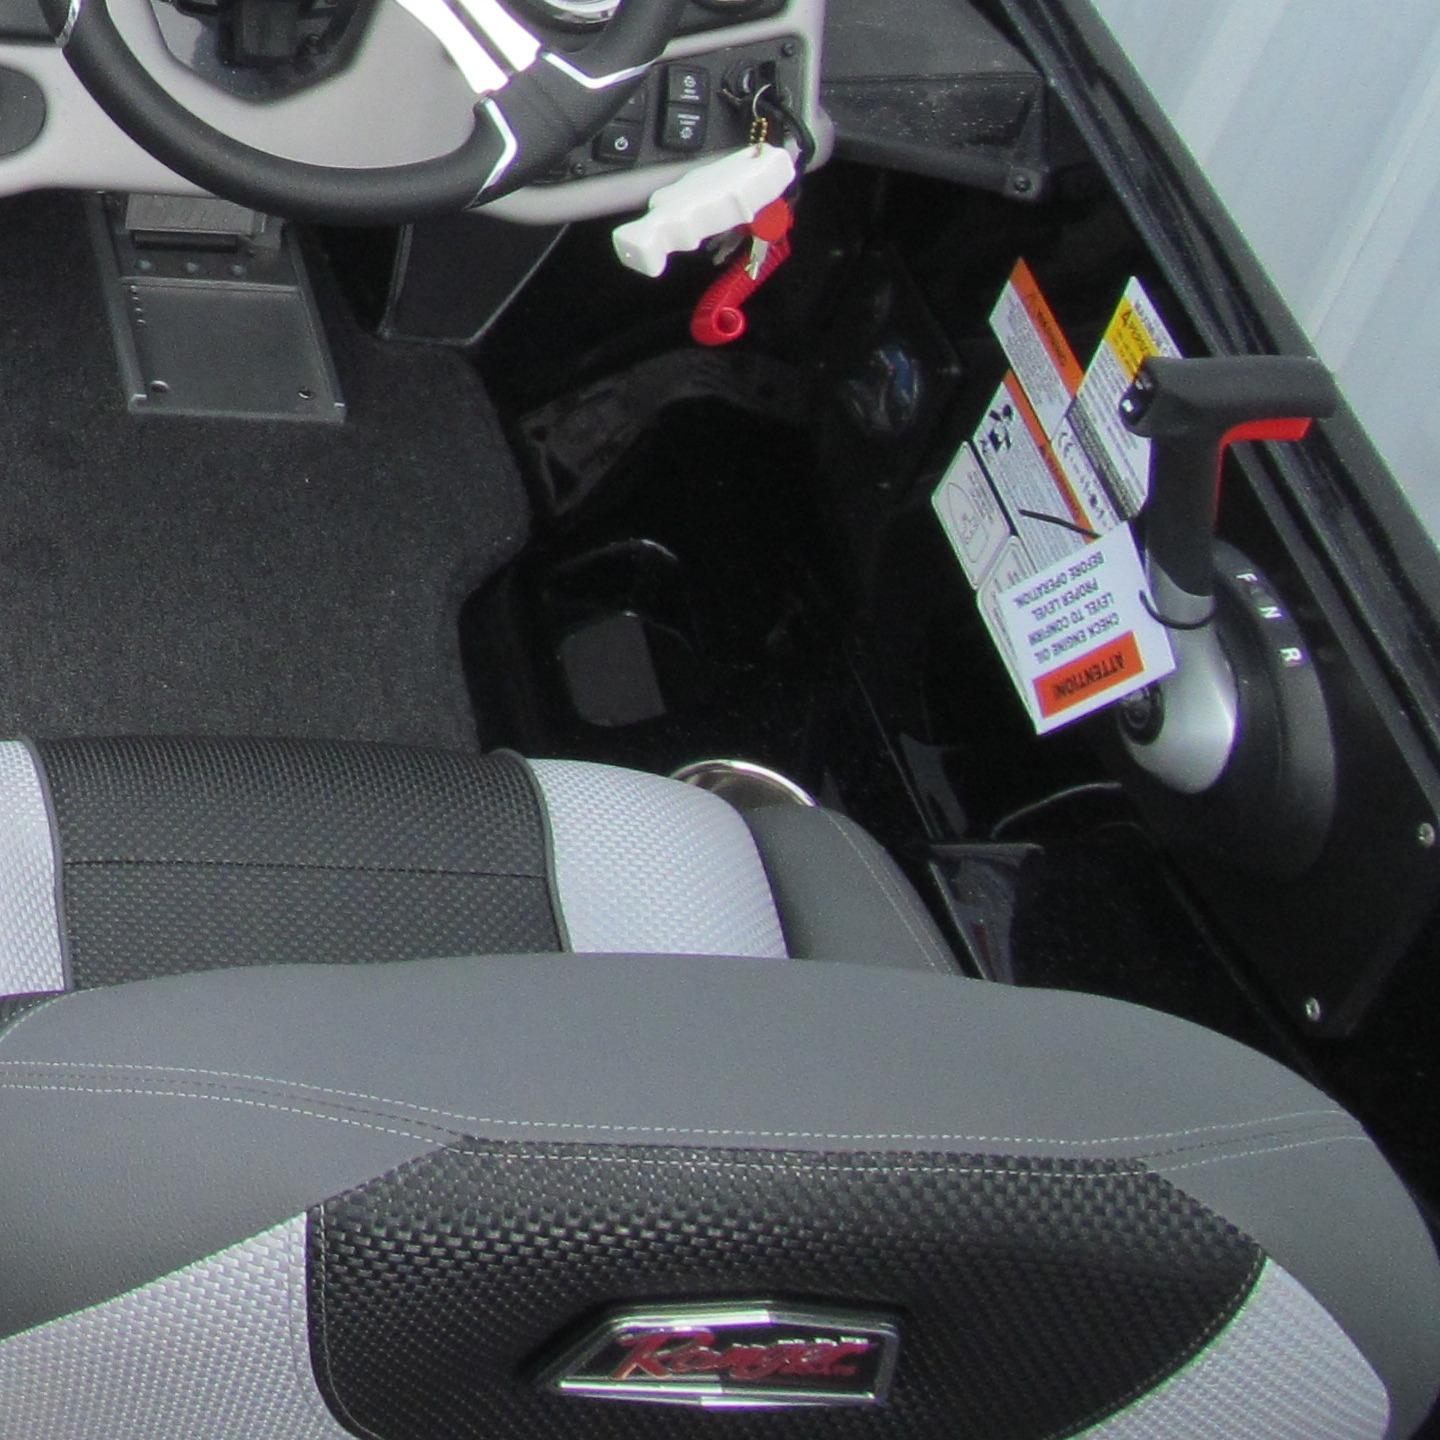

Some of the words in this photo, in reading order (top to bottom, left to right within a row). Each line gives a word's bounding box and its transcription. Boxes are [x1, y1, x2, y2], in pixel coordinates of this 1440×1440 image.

[1067, 551, 1104, 581] BEFORE
[1236, 573, 1258, 581] F
[1060, 577, 1098, 607] PROPER
[1083, 591, 1113, 617] LEVEL
[1030, 597, 1061, 621] LEVEL
[1069, 607, 1084, 624] TO
[1260, 606, 1282, 618] N
[1086, 611, 1121, 639] CHECK
[1051, 628, 1086, 656] ENGINE
[1280, 647, 1301, 661] R
[1033, 647, 1051, 664] OIL
